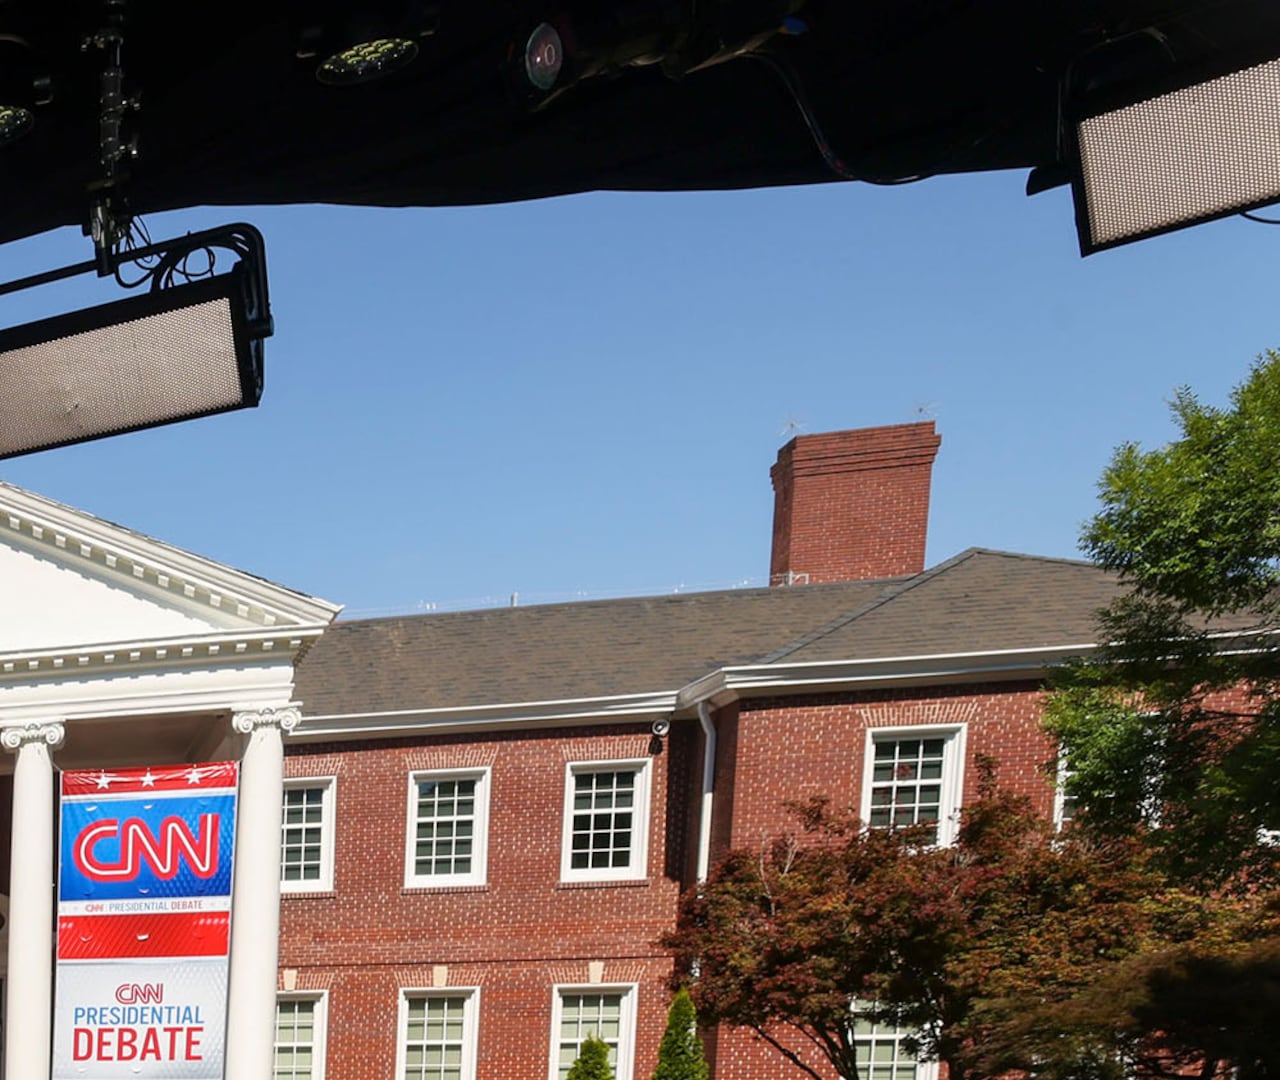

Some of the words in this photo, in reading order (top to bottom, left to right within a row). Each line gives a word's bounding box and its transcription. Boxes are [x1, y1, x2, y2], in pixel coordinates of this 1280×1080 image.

[73, 813, 220, 882] CNN
[85, 903, 104, 913] CNN
[109, 902, 169, 913] PRESIDENTIAL
[171, 900, 203, 911] DEBATE
[115, 983, 163, 1005] CNN
[74, 1006, 205, 1026] PRESIDENTIAL
[73, 1027, 204, 1062] DEBATE
